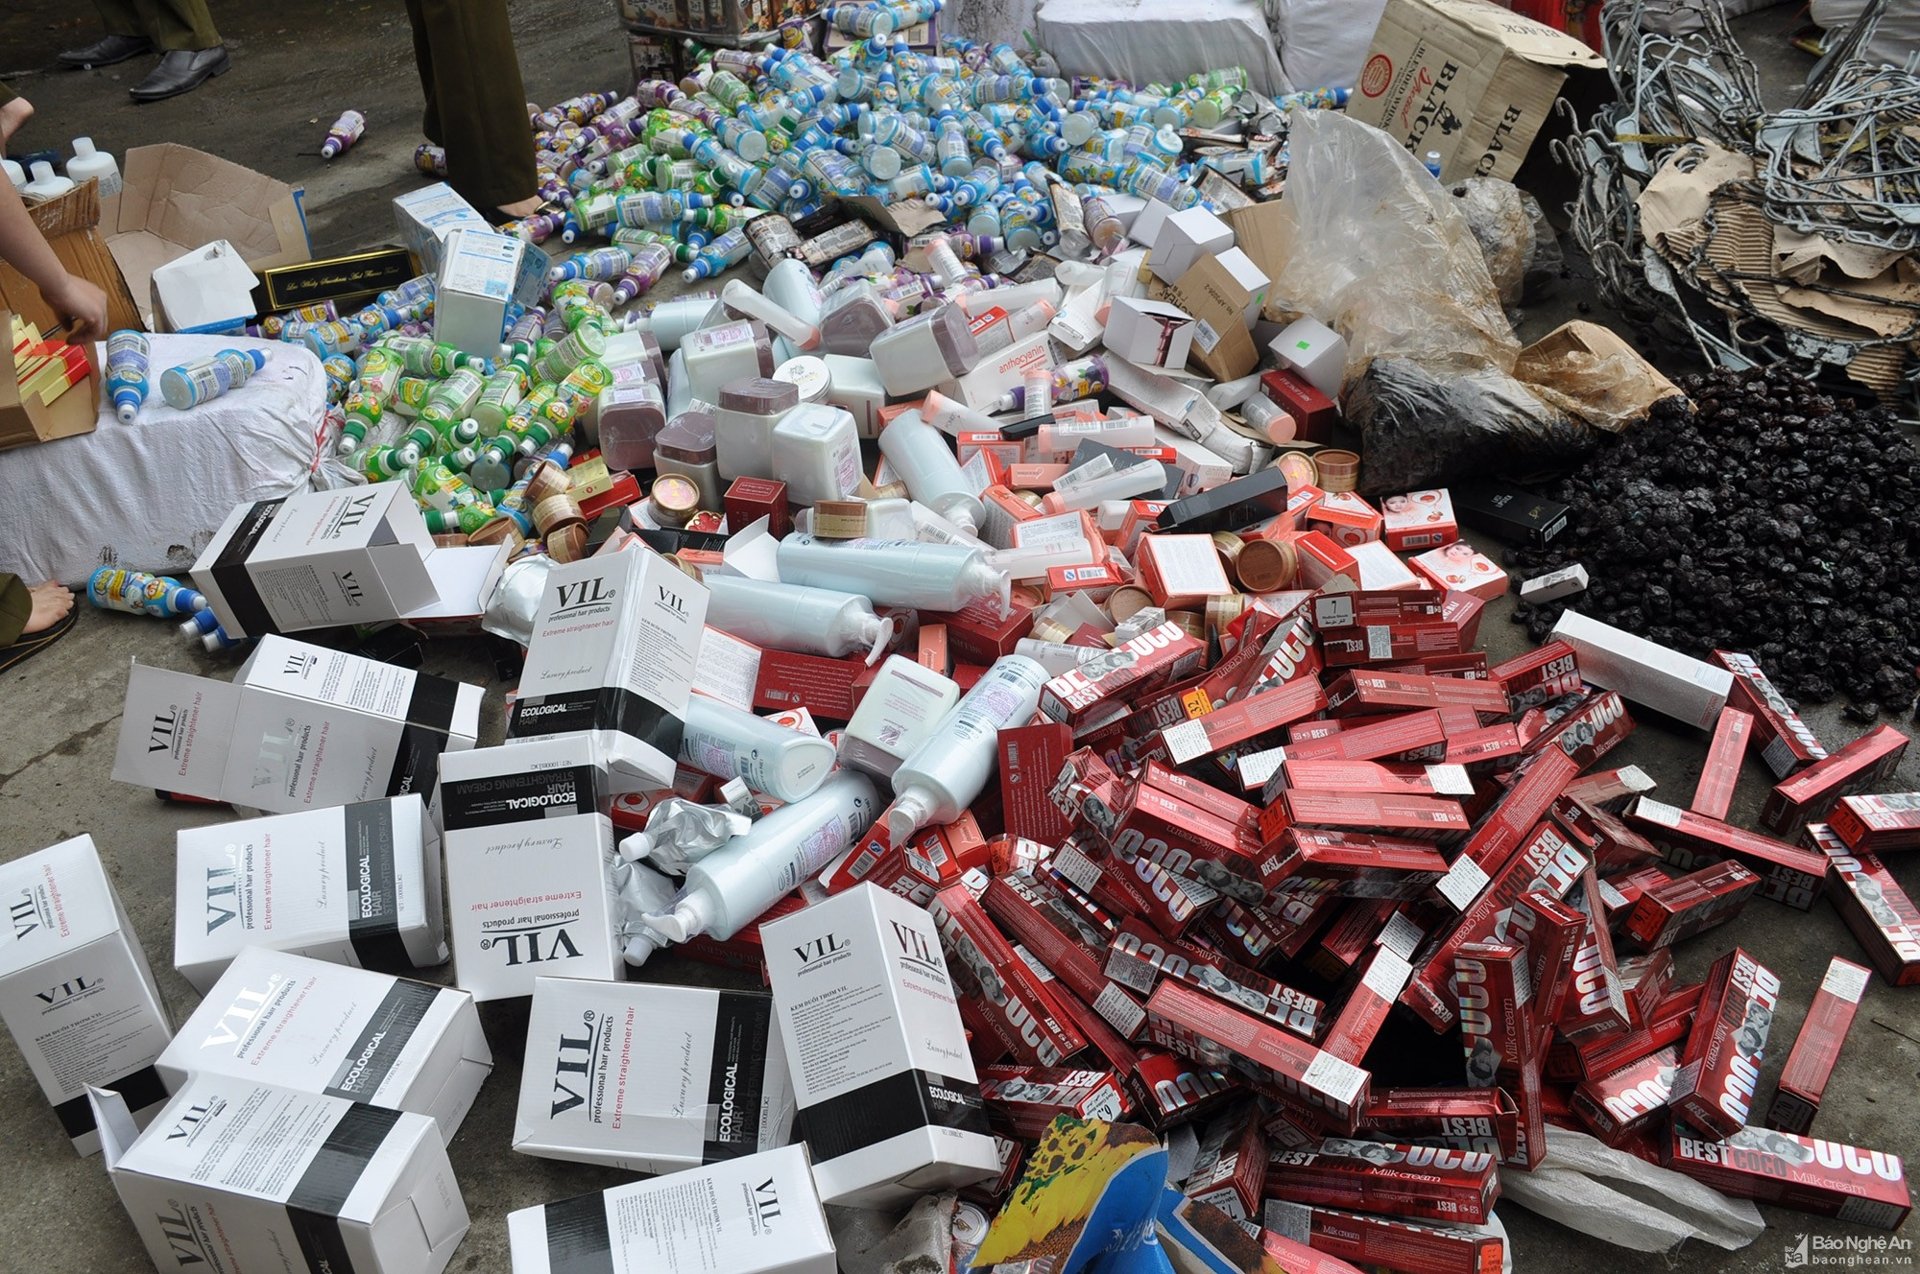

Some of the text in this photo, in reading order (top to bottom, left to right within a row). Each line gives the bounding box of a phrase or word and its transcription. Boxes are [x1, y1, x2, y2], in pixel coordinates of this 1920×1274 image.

[1399, 47, 1426, 95] BLENDED
[1384, 97, 1402, 129] WHISK
[1404, 60, 1459, 155] BLACK
[999, 344, 1045, 374] anthocyanin
[548, 611, 577, 622] professional
[589, 606, 610, 616] products
[1331, 600, 1337, 614] 7
[542, 627, 567, 637] Extreme
[567, 621, 603, 633] straightener
[1346, 639, 1364, 653] BEST
[1217, 642, 1260, 679] Milk cream
[1542, 654, 1574, 682] BEST
[521, 703, 567, 717] ECOLOGICAL
[1066, 683, 1105, 710] BEST
[1154, 697, 1183, 729] BEST
[179, 748, 191, 777] Extreme
[186, 705, 200, 747] straightener
[1311, 728, 1328, 741] BEST
[1483, 740, 1500, 752] BEST
[1593, 736, 1621, 759] Milk cream
[289, 725, 311, 798] professional hair products
[304, 776, 317, 804] Extreme
[311, 734, 327, 775] straightener
[456, 771, 575, 795] STRAIGHTENING CREAM
[547, 781, 575, 792] HAIR
[506, 792, 576, 810] ECOLOGICAL
[246, 844, 254, 872] products
[1261, 854, 1281, 877] BEST
[1523, 828, 1563, 875] BEST
[264, 849, 272, 896] straightener
[360, 855, 372, 918] ECOLOGICAL
[1106, 860, 1151, 913] Milk cream
[1770, 865, 1815, 890] BEST
[372, 890, 382, 916] HAIR
[471, 890, 582, 911] Extreme straightener hair
[1002, 875, 1047, 908] BEST
[246, 890, 254, 929] professional
[264, 899, 272, 930] Extreme
[483, 909, 580, 928] professional hair products
[1251, 906, 1266, 922] BEST
[1450, 899, 1496, 949] Milk cream
[797, 963, 822, 977] professional
[833, 951, 852, 963] products
[1563, 944, 1575, 962] BEST
[1731, 954, 1758, 996] BEST
[1269, 983, 1318, 1015] BEST
[1432, 1002, 1453, 1023] BEST
[236, 980, 297, 1059] professional hair products
[251, 976, 318, 1067] Extreme straightener hair
[977, 1001, 1020, 1057] Milk cream
[1044, 1017, 1061, 1033] BEST
[1503, 998, 1518, 1064] Milk cream
[1154, 1029, 1199, 1062] BEST
[1706, 1021, 1728, 1071] Milk cream
[340, 1031, 387, 1092] ECOLOGICAL
[594, 1016, 614, 1123] professional hair products
[613, 1007, 634, 1130] Extreme straightener hair
[672, 1031, 695, 1119] Luxury product
[1058, 1070, 1106, 1088] BEST
[719, 1063, 738, 1142] ECOLOGICAL
[928, 1085, 966, 1105] ECOLOGICAL
[1685, 1102, 1705, 1120] BEST
[730, 1111, 744, 1144] HAIR
[1441, 1117, 1492, 1137] BEST
[1269, 1151, 1319, 1167] BEST
[1680, 1137, 1729, 1166] BEST
[1734, 1149, 1787, 1177] COCO
[1370, 1167, 1441, 1183] Milk cream
[1792, 1170, 1867, 1196] Milk cream
[1436, 1201, 1457, 1212] BEST
[1322, 1224, 1360, 1241] Milk cream
[1271, 1243, 1311, 1266] Milk cream
